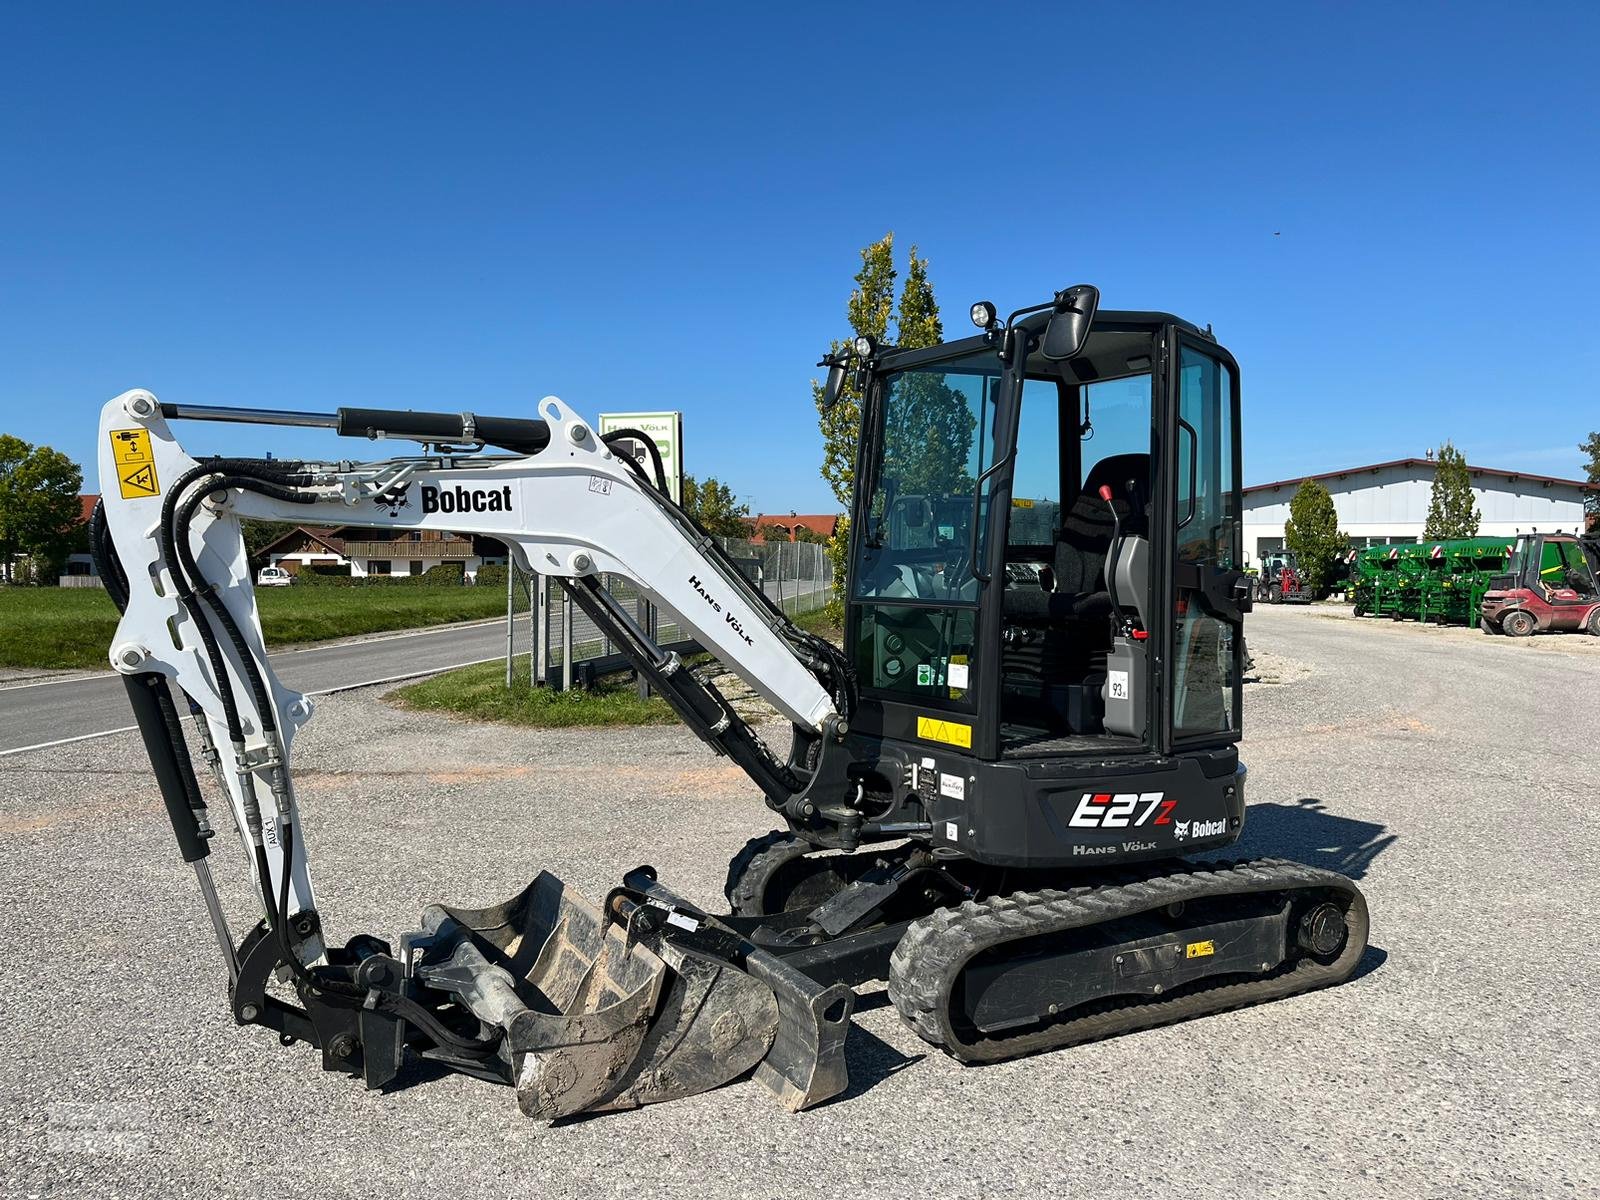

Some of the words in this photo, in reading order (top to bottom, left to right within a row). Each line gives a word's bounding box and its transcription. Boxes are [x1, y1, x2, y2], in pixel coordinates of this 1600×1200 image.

[421, 485, 512, 514] Bobcat
[688, 575, 722, 612] HANS
[725, 611, 754, 647] VÖLK
[266, 826, 278, 845] AUX
[1192, 818, 1226, 838] Bobcat
[1072, 845, 1116, 856] HANS
[1122, 841, 1157, 852] VÖLK
